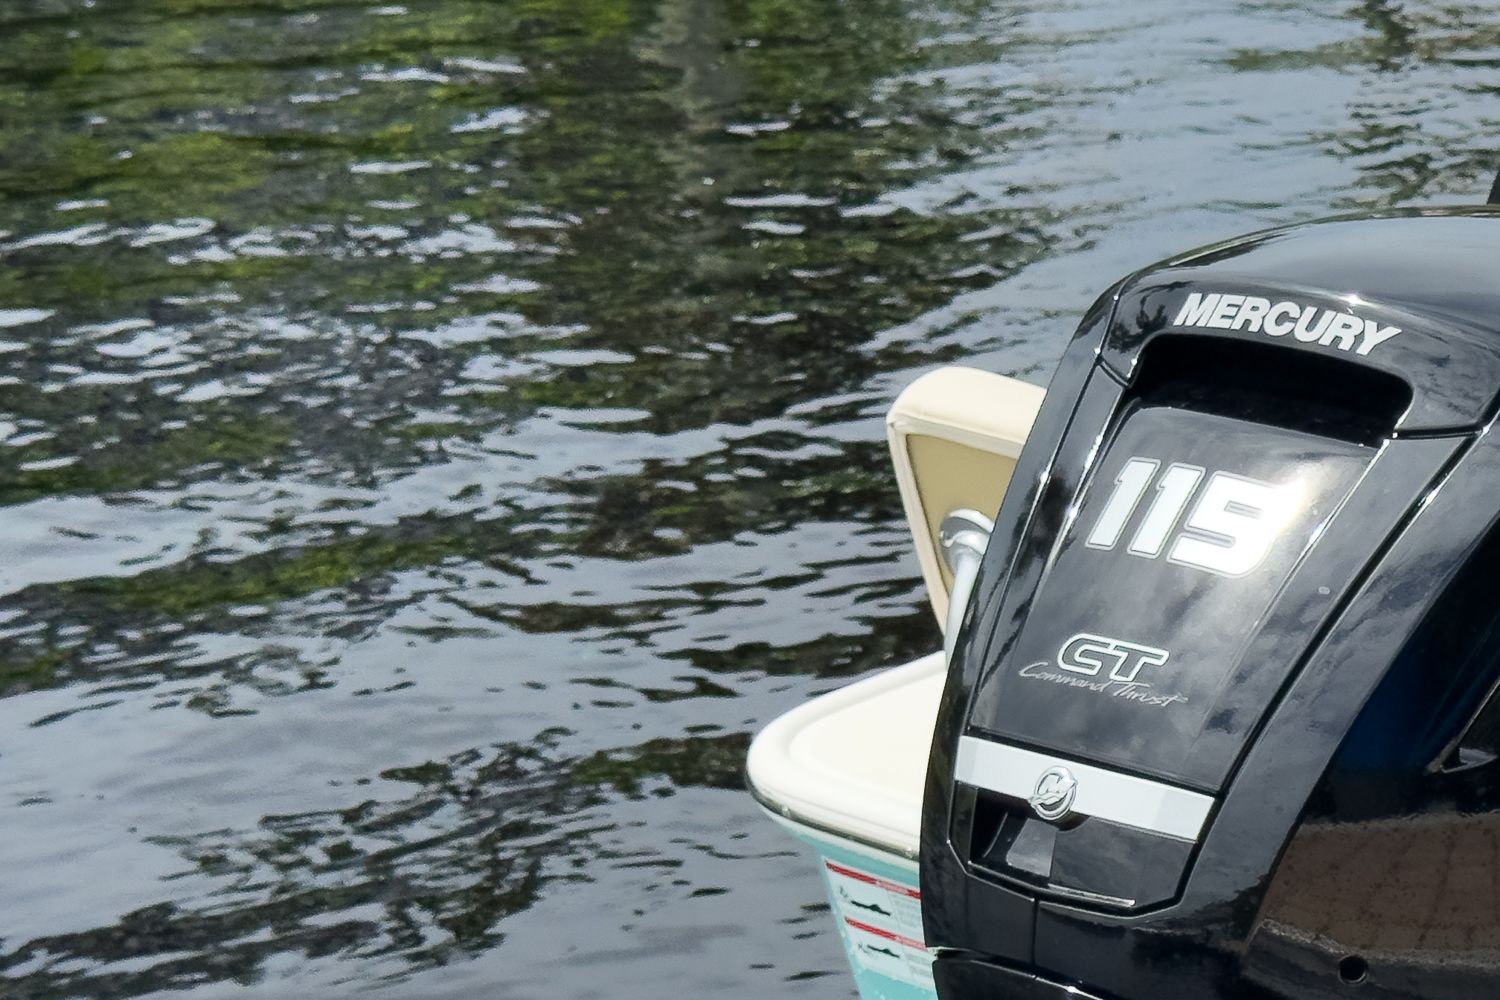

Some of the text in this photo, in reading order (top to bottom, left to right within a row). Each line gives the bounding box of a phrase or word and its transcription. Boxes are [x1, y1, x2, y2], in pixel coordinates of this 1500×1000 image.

[1173, 293, 1402, 355] MERCURY
[1085, 456, 1294, 578] 115
[1019, 661, 1112, 692] Command
